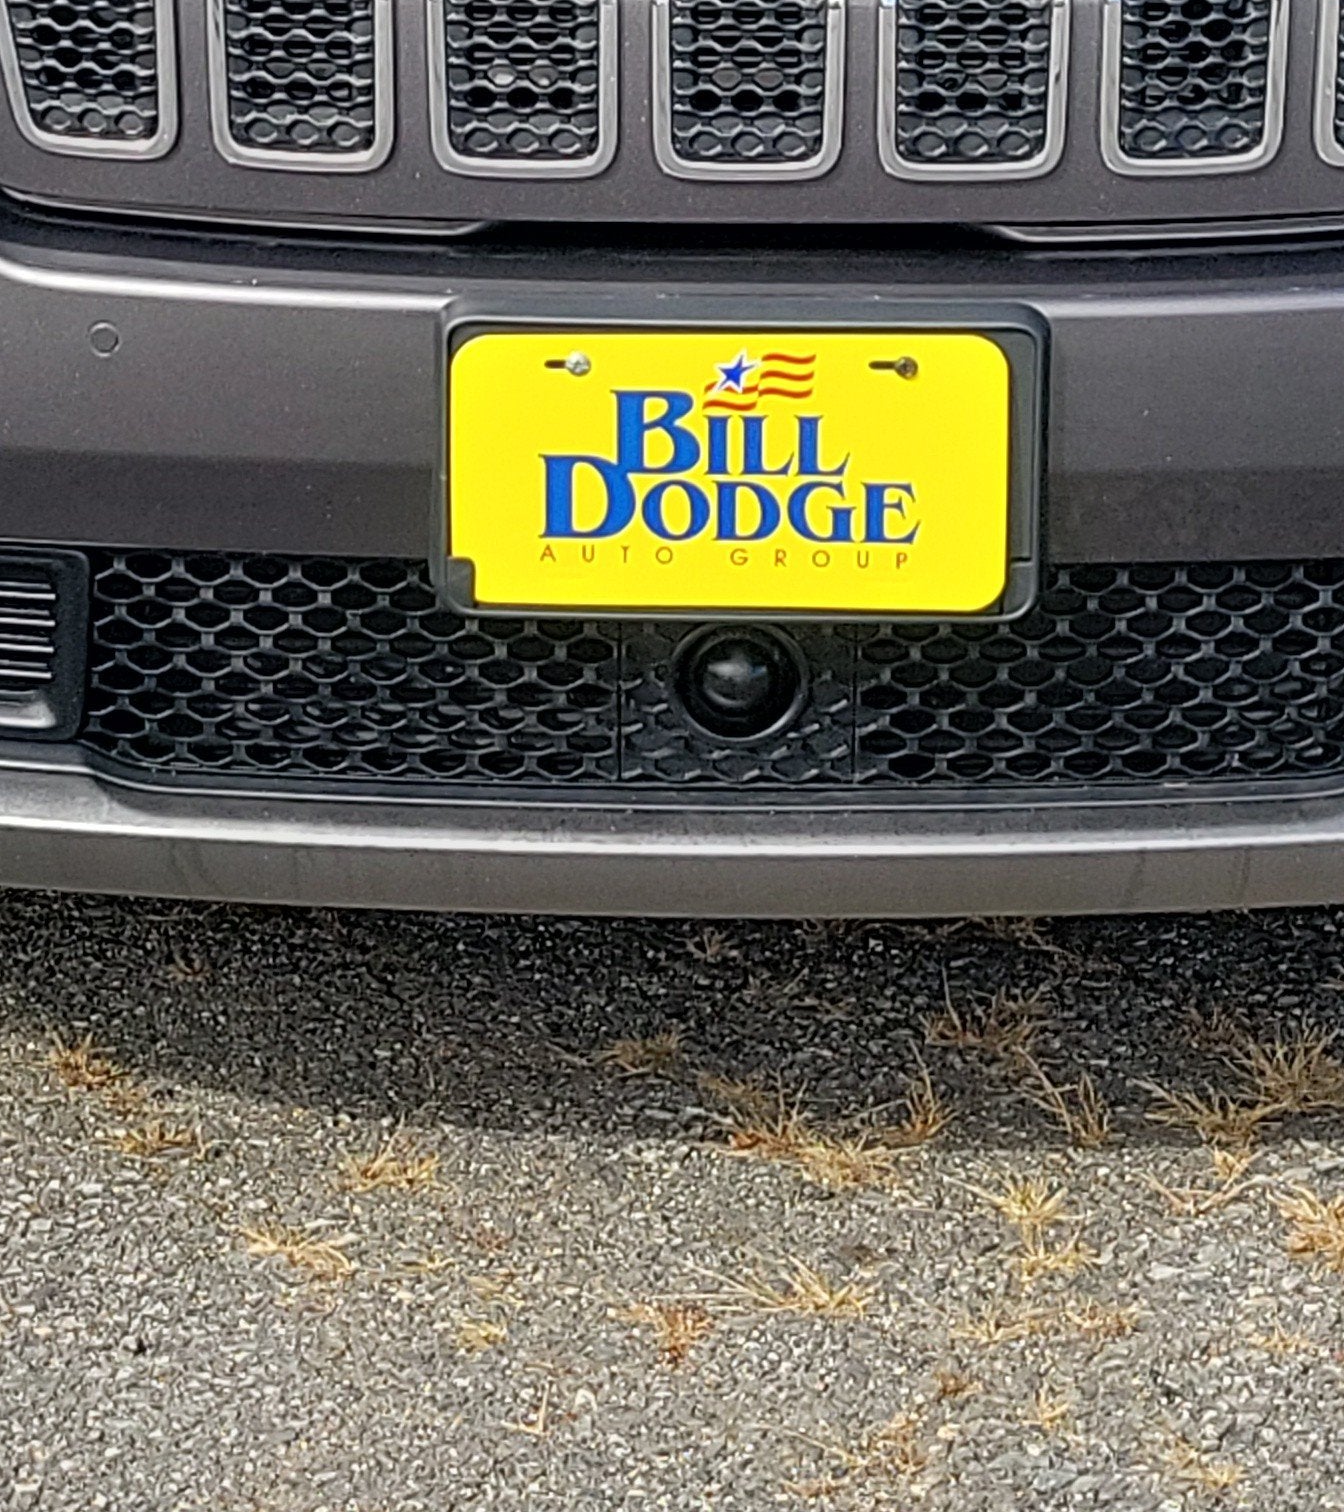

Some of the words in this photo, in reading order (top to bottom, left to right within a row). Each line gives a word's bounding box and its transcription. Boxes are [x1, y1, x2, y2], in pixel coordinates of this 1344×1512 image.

[611, 389, 850, 477] BILL
[538, 453, 921, 545] DODGE
[539, 545, 675, 565] AUTO
[729, 547, 910, 571] GROUP
